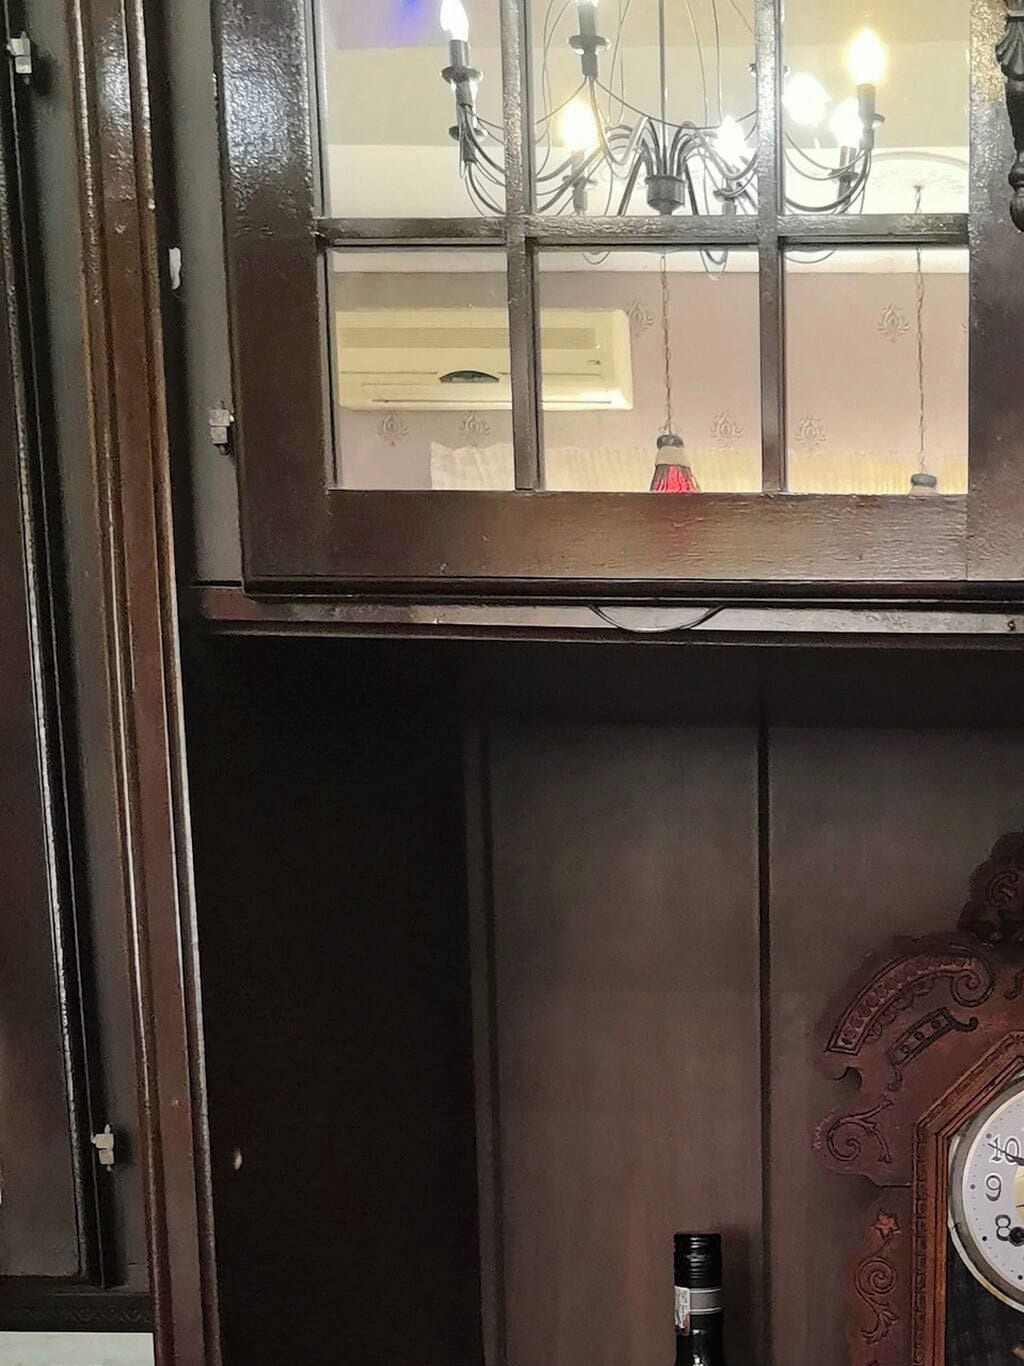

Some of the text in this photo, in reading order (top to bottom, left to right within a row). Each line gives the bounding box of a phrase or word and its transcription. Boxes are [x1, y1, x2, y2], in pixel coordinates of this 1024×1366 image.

[990, 1137, 1023, 1164] 10
[985, 1174, 1002, 1202] 9
[995, 1214, 1013, 1242] 8
